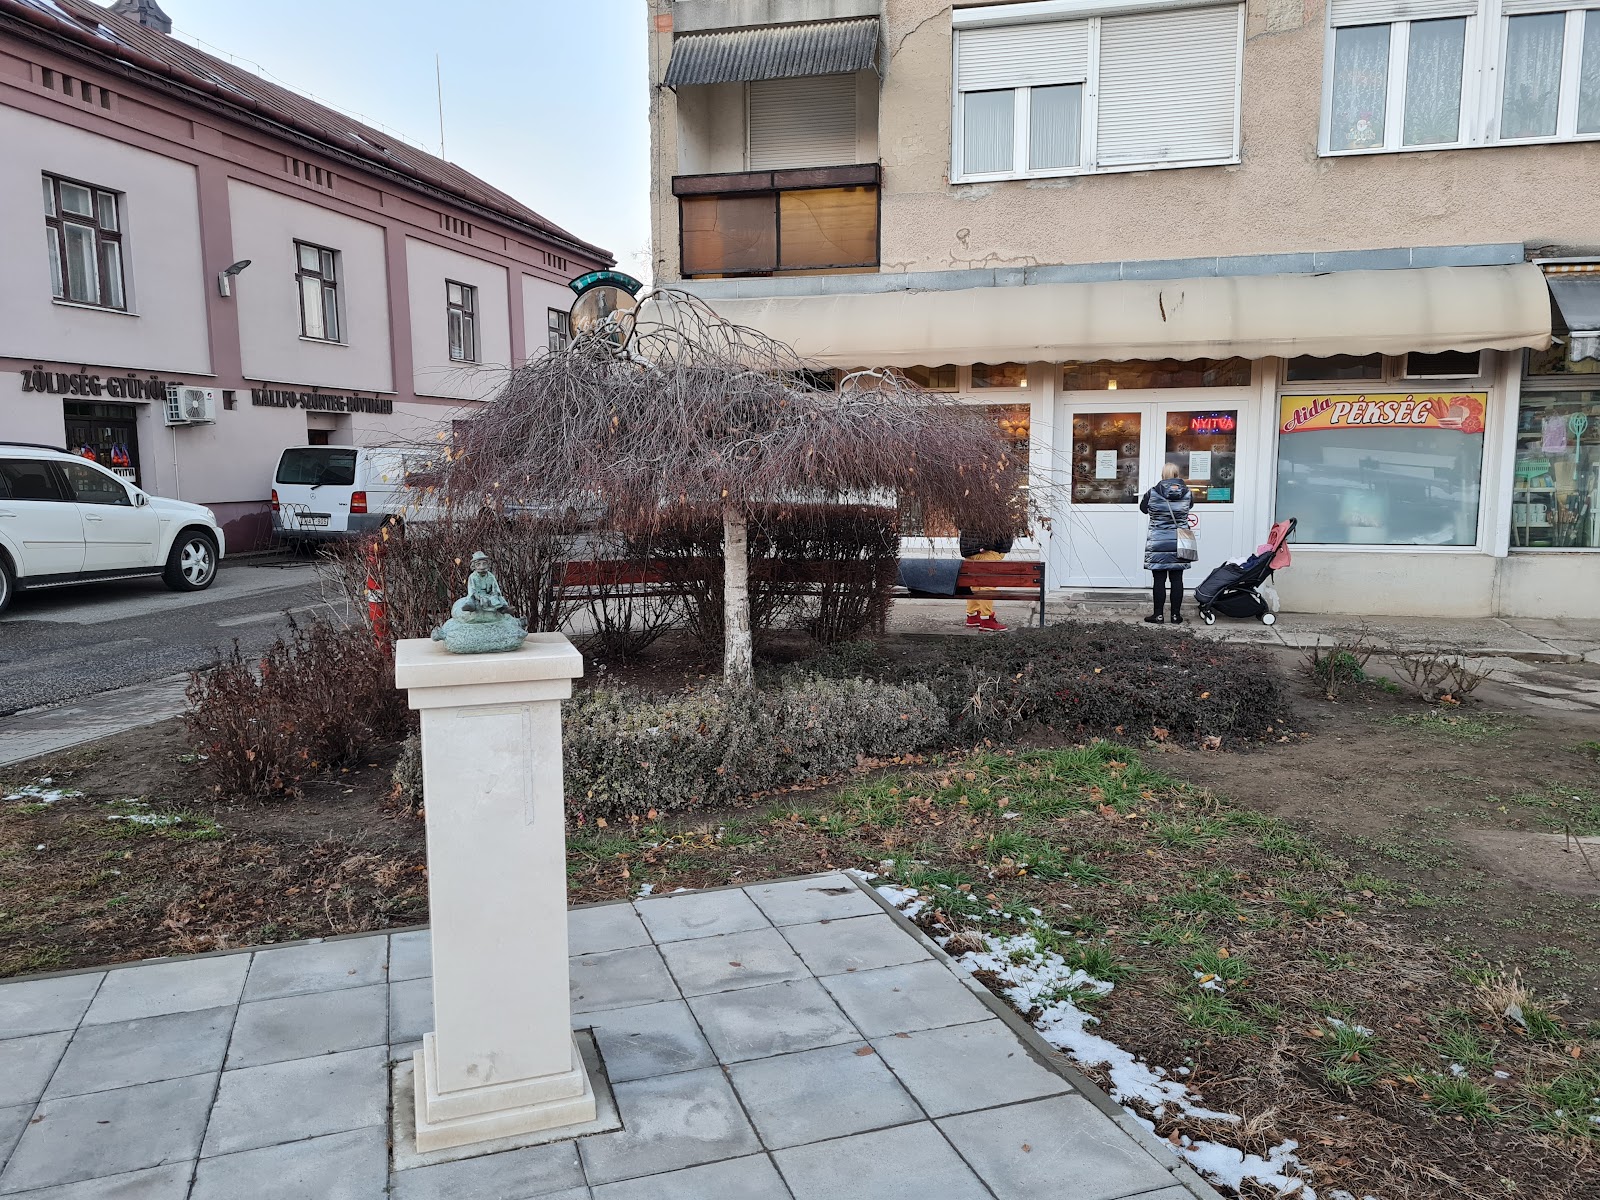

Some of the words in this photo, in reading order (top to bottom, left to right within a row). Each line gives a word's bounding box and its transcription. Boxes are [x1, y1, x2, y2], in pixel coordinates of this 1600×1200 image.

[20, 364, 184, 401] ZÖLDSÉG-GYÜMÖL
[1191, 418, 1234, 429] NYITVA
[1284, 397, 1334, 432] Aida
[1330, 394, 1433, 425] PÉKSÉG
